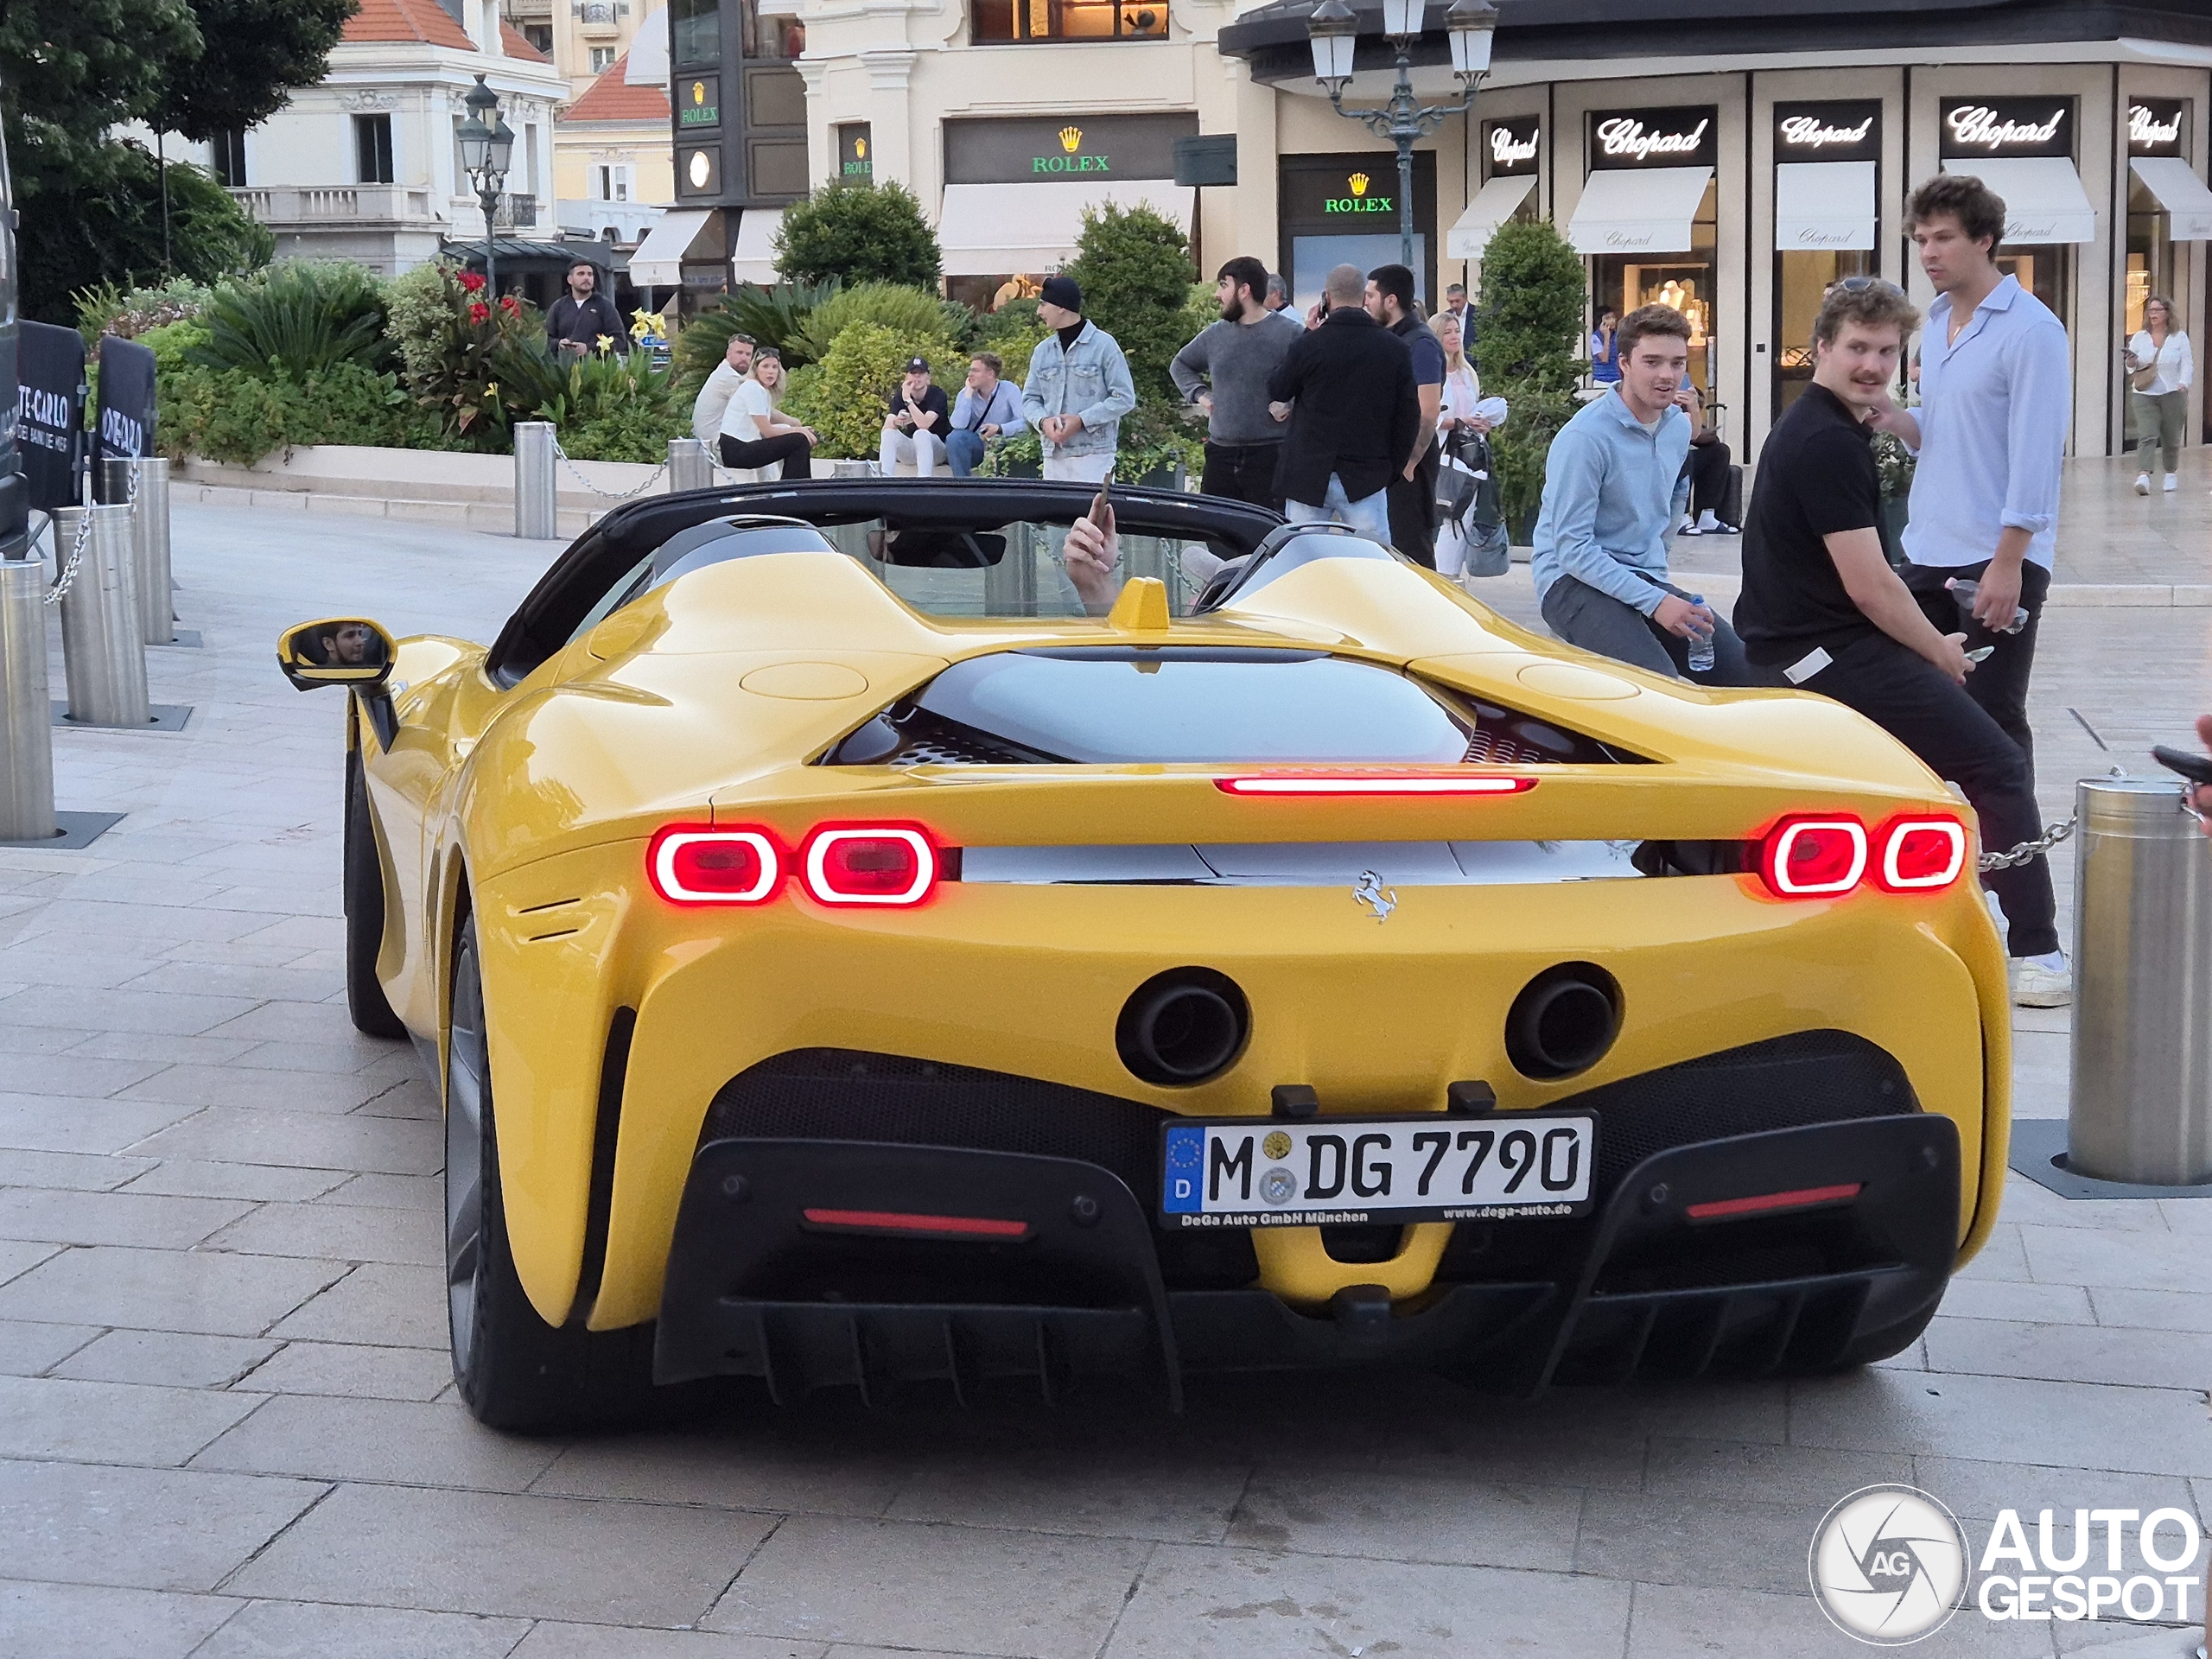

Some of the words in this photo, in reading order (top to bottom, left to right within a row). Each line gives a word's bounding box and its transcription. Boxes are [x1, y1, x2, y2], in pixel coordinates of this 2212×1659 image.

[682, 106, 718, 124] ROLEX
[1780, 116, 1873, 149] Chopard
[1948, 105, 2066, 149] Chopard
[2128, 105, 2183, 149] Chopard
[1491, 127, 1539, 168] Chopard
[1598, 117, 1709, 161] Chopard
[843, 161, 873, 175] ROLE
[1032, 156, 1110, 173] ROLEX
[1324, 197, 1394, 213] ROLEX
[1796, 227, 1854, 245] Chopard
[2005, 220, 2056, 239] Chopard
[1603, 230, 1655, 249] Chopard
[17, 385, 68, 429] TE-CARLO
[1209, 1135, 1254, 1201] M
[1304, 1134, 1392, 1199] DG
[1412, 1128, 1579, 1196] 7790
[1175, 1179, 1191, 1198] D
[1181, 1214, 1221, 1226] DeGa
[1223, 1213, 1257, 1225] Auto
[1260, 1212, 1303, 1225] GmbH
[1305, 1211, 1369, 1224] München
[1443, 1203, 1573, 1220] www.dega-auto.de
